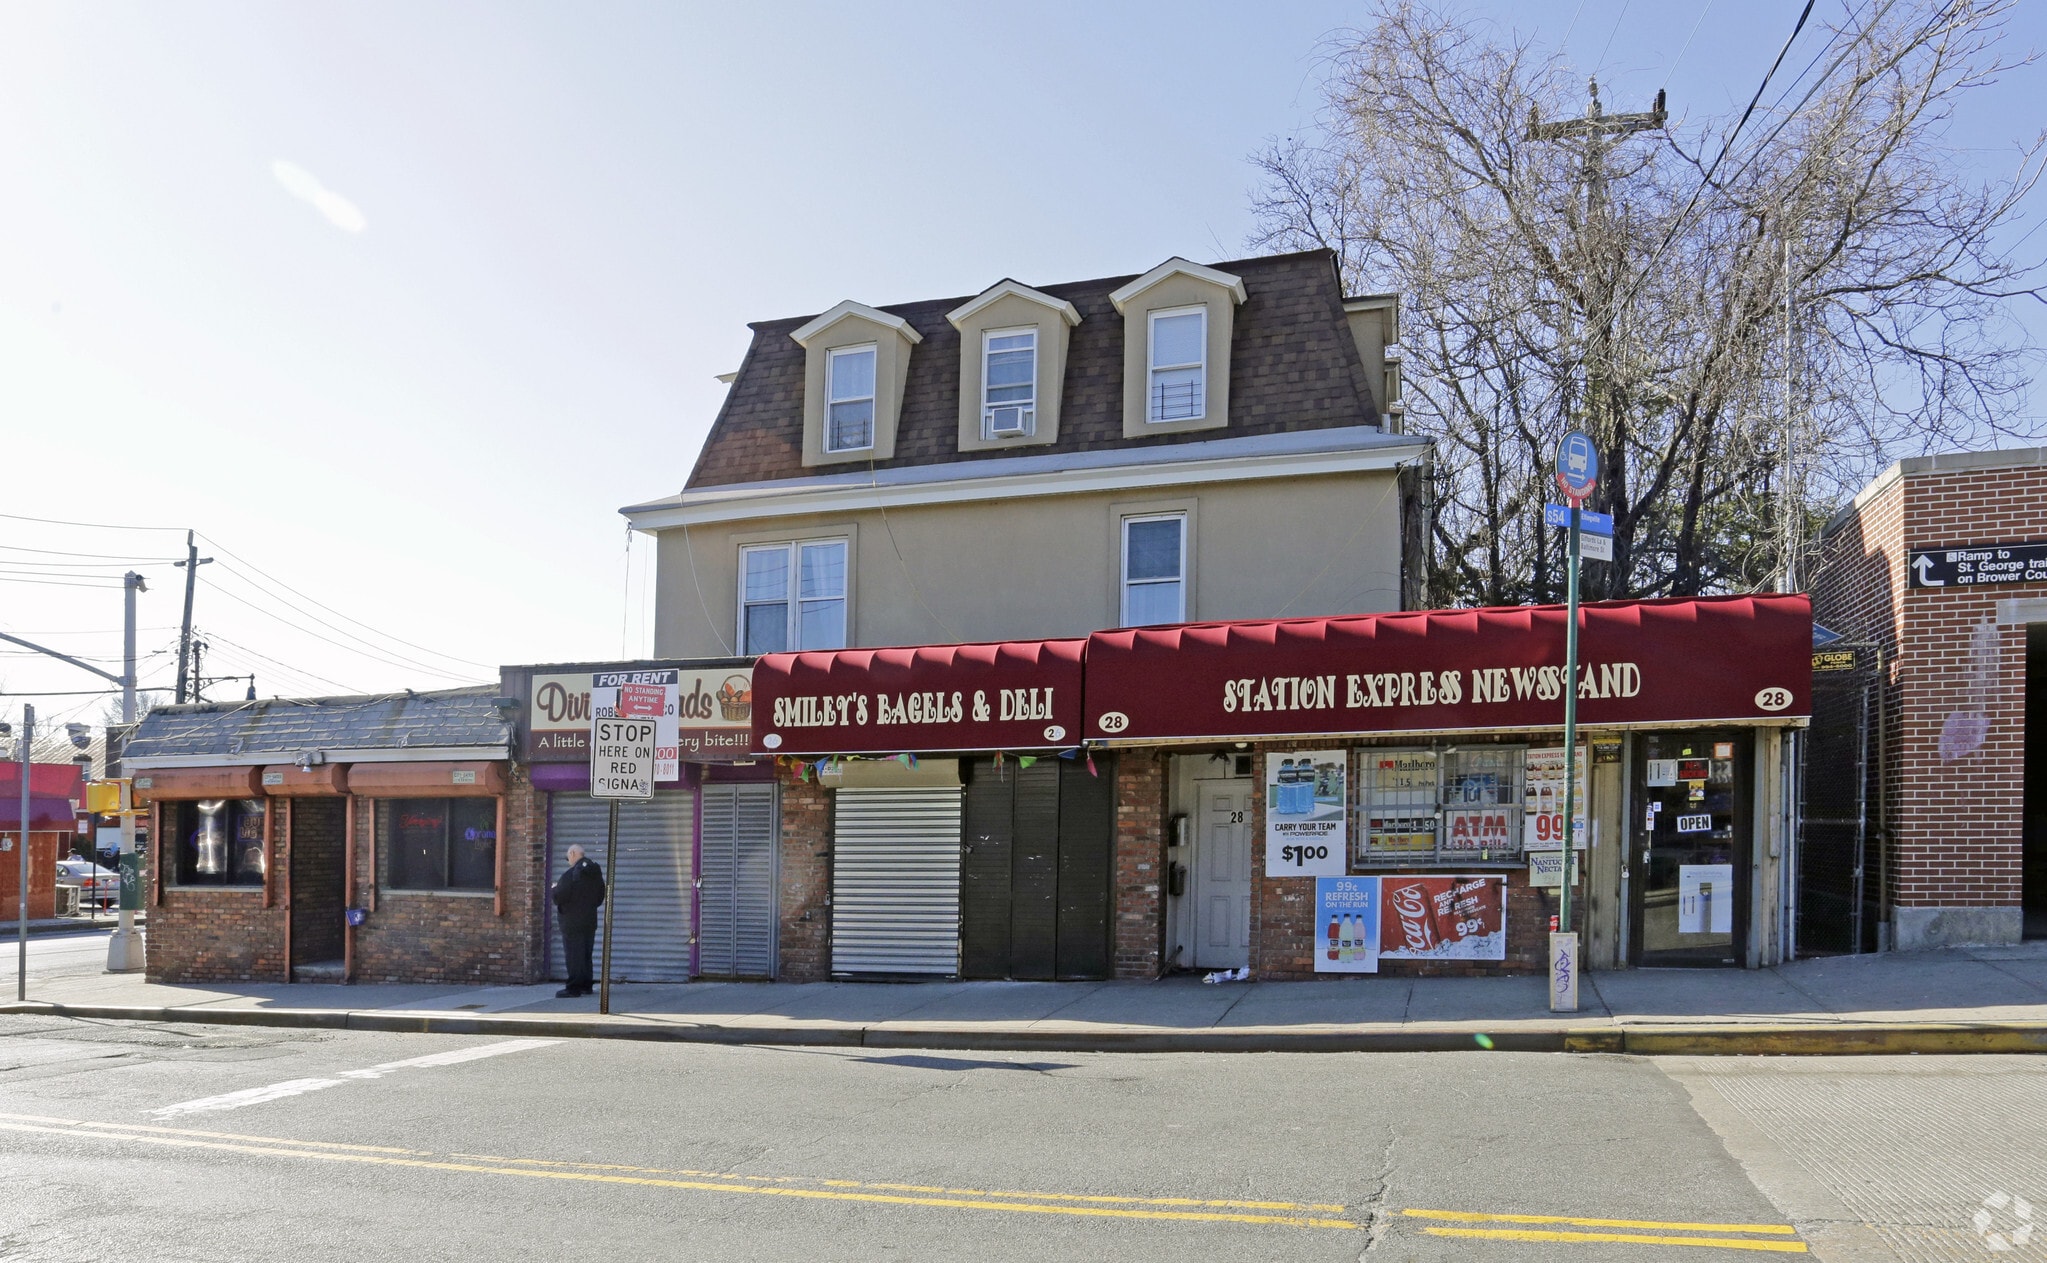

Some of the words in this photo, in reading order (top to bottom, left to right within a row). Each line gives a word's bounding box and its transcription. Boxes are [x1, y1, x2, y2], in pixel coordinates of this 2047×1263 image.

[1561, 476, 1569, 488] NO
[1547, 509, 1565, 524] S54
[1958, 551, 1993, 562] Ramp
[1997, 549, 2010, 559] to
[1957, 562, 1974, 573] St.
[1978, 560, 2024, 572] George
[1957, 575, 1973, 584] on
[1977, 572, 2021, 583] Brower
[1824, 653, 1853, 662] GLOBE
[598, 674, 628, 687] FOR
[631, 671, 671, 684] RENT
[624, 686, 633, 694] NO
[635, 686, 664, 696] STANDING
[1222, 674, 1337, 713] STATION
[1345, 669, 1462, 709] EXPRESS
[536, 681, 592, 723] Divi
[628, 695, 658, 704] ANYTIME
[1762, 691, 1786, 707] 28
[773, 692, 869, 728] SMILEY'S
[876, 690, 963, 725] BAGELS
[971, 689, 991, 722] &
[999, 687, 1054, 722] DELI
[1104, 715, 1123, 729] 28
[599, 723, 652, 742] STOP
[538, 736, 550, 748] A
[553, 733, 585, 748] little
[678, 737, 700, 753] ery
[704, 731, 749, 746] bite!!!
[599, 745, 628, 758] HERE
[635, 746, 650, 759] ON
[610, 761, 637, 774] RED
[598, 777, 645, 792] SIGNA
[1230, 811, 1244, 824] 28
[1680, 815, 1709, 831] OPEN
[1274, 823, 1297, 832] CARRY
[1298, 823, 1317, 831] YOUR
[1318, 822, 1337, 831] TEAM
[1452, 815, 1507, 837] ATM
[1536, 814, 1570, 841] 99
[1281, 844, 1328, 867] $100
[1530, 856, 1578, 866] NANTUCT
[1536, 866, 1563, 874] NECTA
[1336, 881, 1358, 892] 99¢
[1325, 892, 1369, 901] REFRESH
